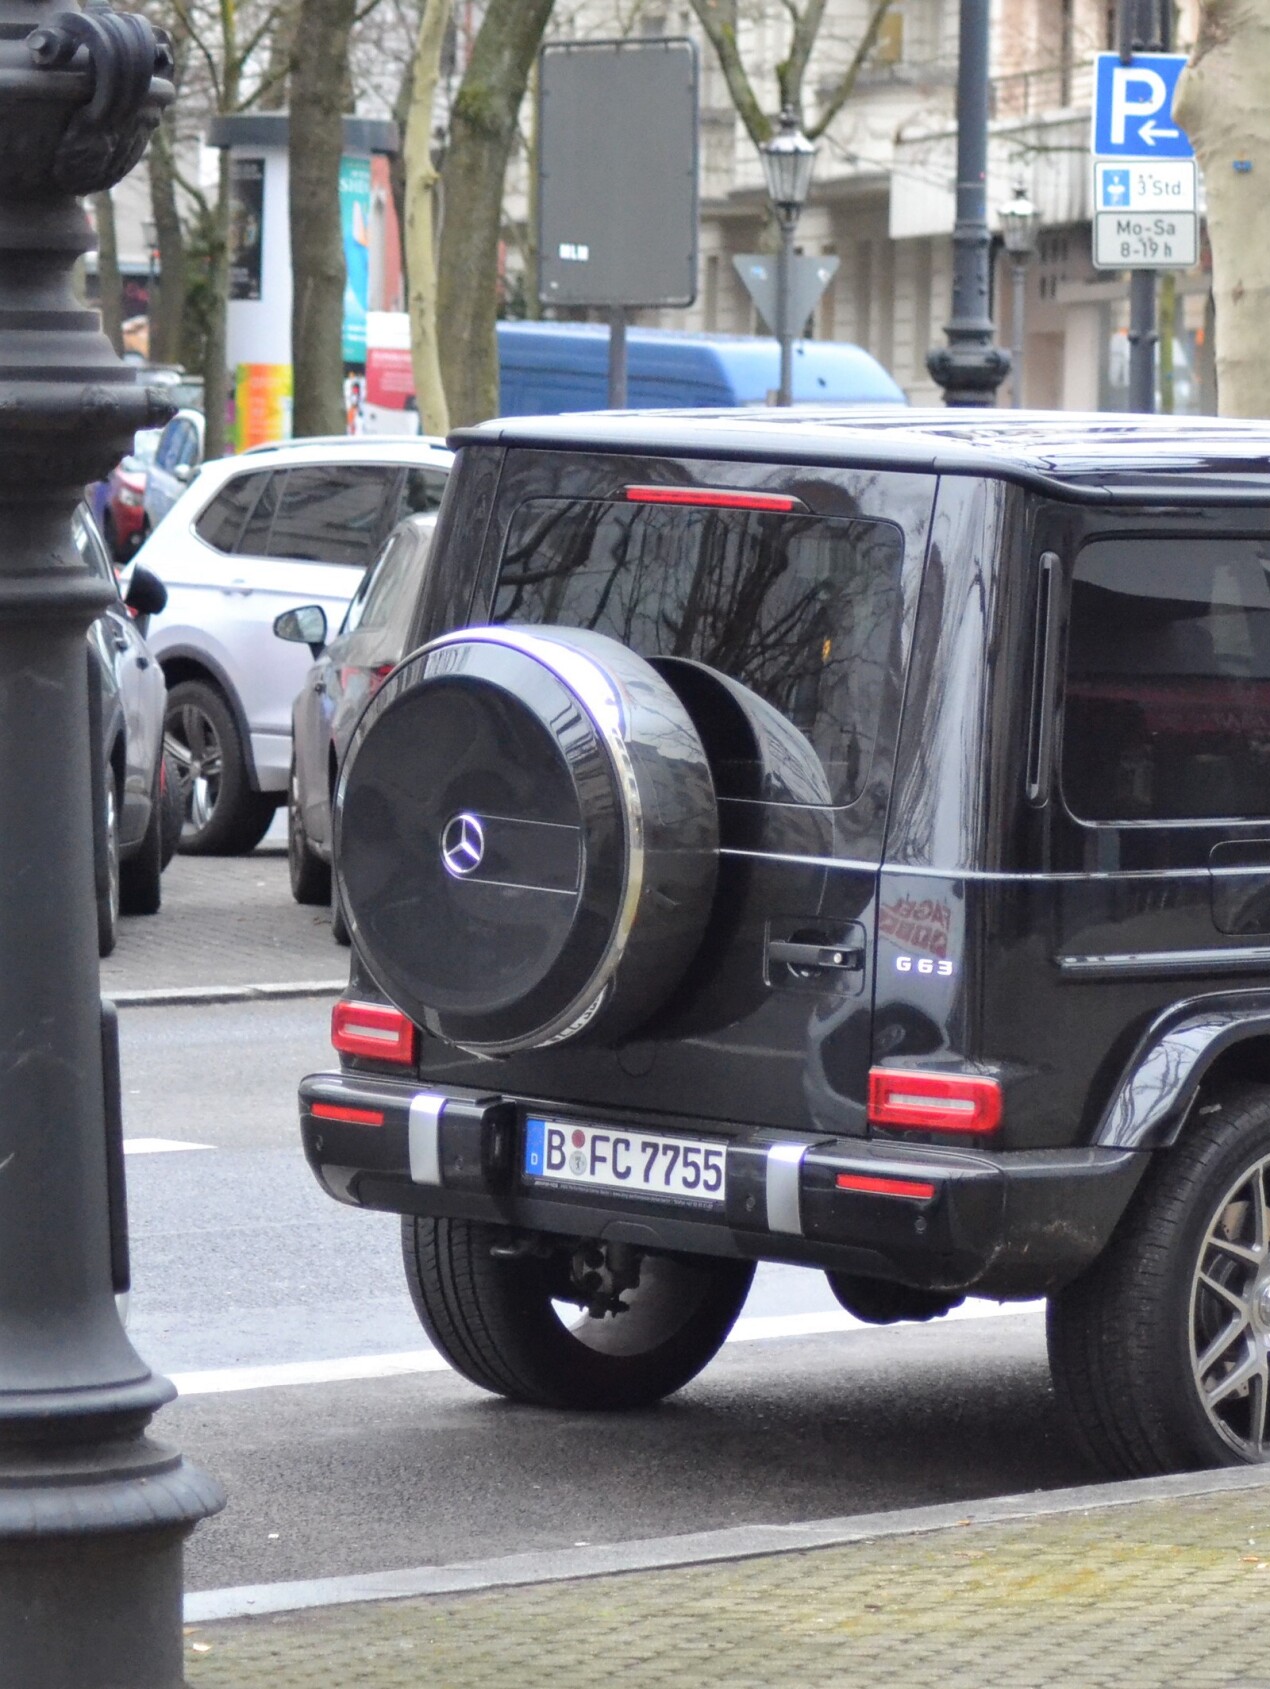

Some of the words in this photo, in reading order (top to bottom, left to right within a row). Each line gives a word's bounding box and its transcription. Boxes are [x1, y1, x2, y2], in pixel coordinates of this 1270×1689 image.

[1111, 67, 1166, 144] P
[1138, 181, 1147, 195] 3
[1153, 180, 1181, 195] Std
[1117, 220, 1175, 236] Mo-Sa
[1121, 243, 1157, 257] 8-19
[1164, 242, 1172, 256] h
[530, 1153, 538, 1165] D
[546, 1129, 566, 1170] B
[590, 1134, 632, 1180] FC
[641, 1141, 723, 1192] 7755
